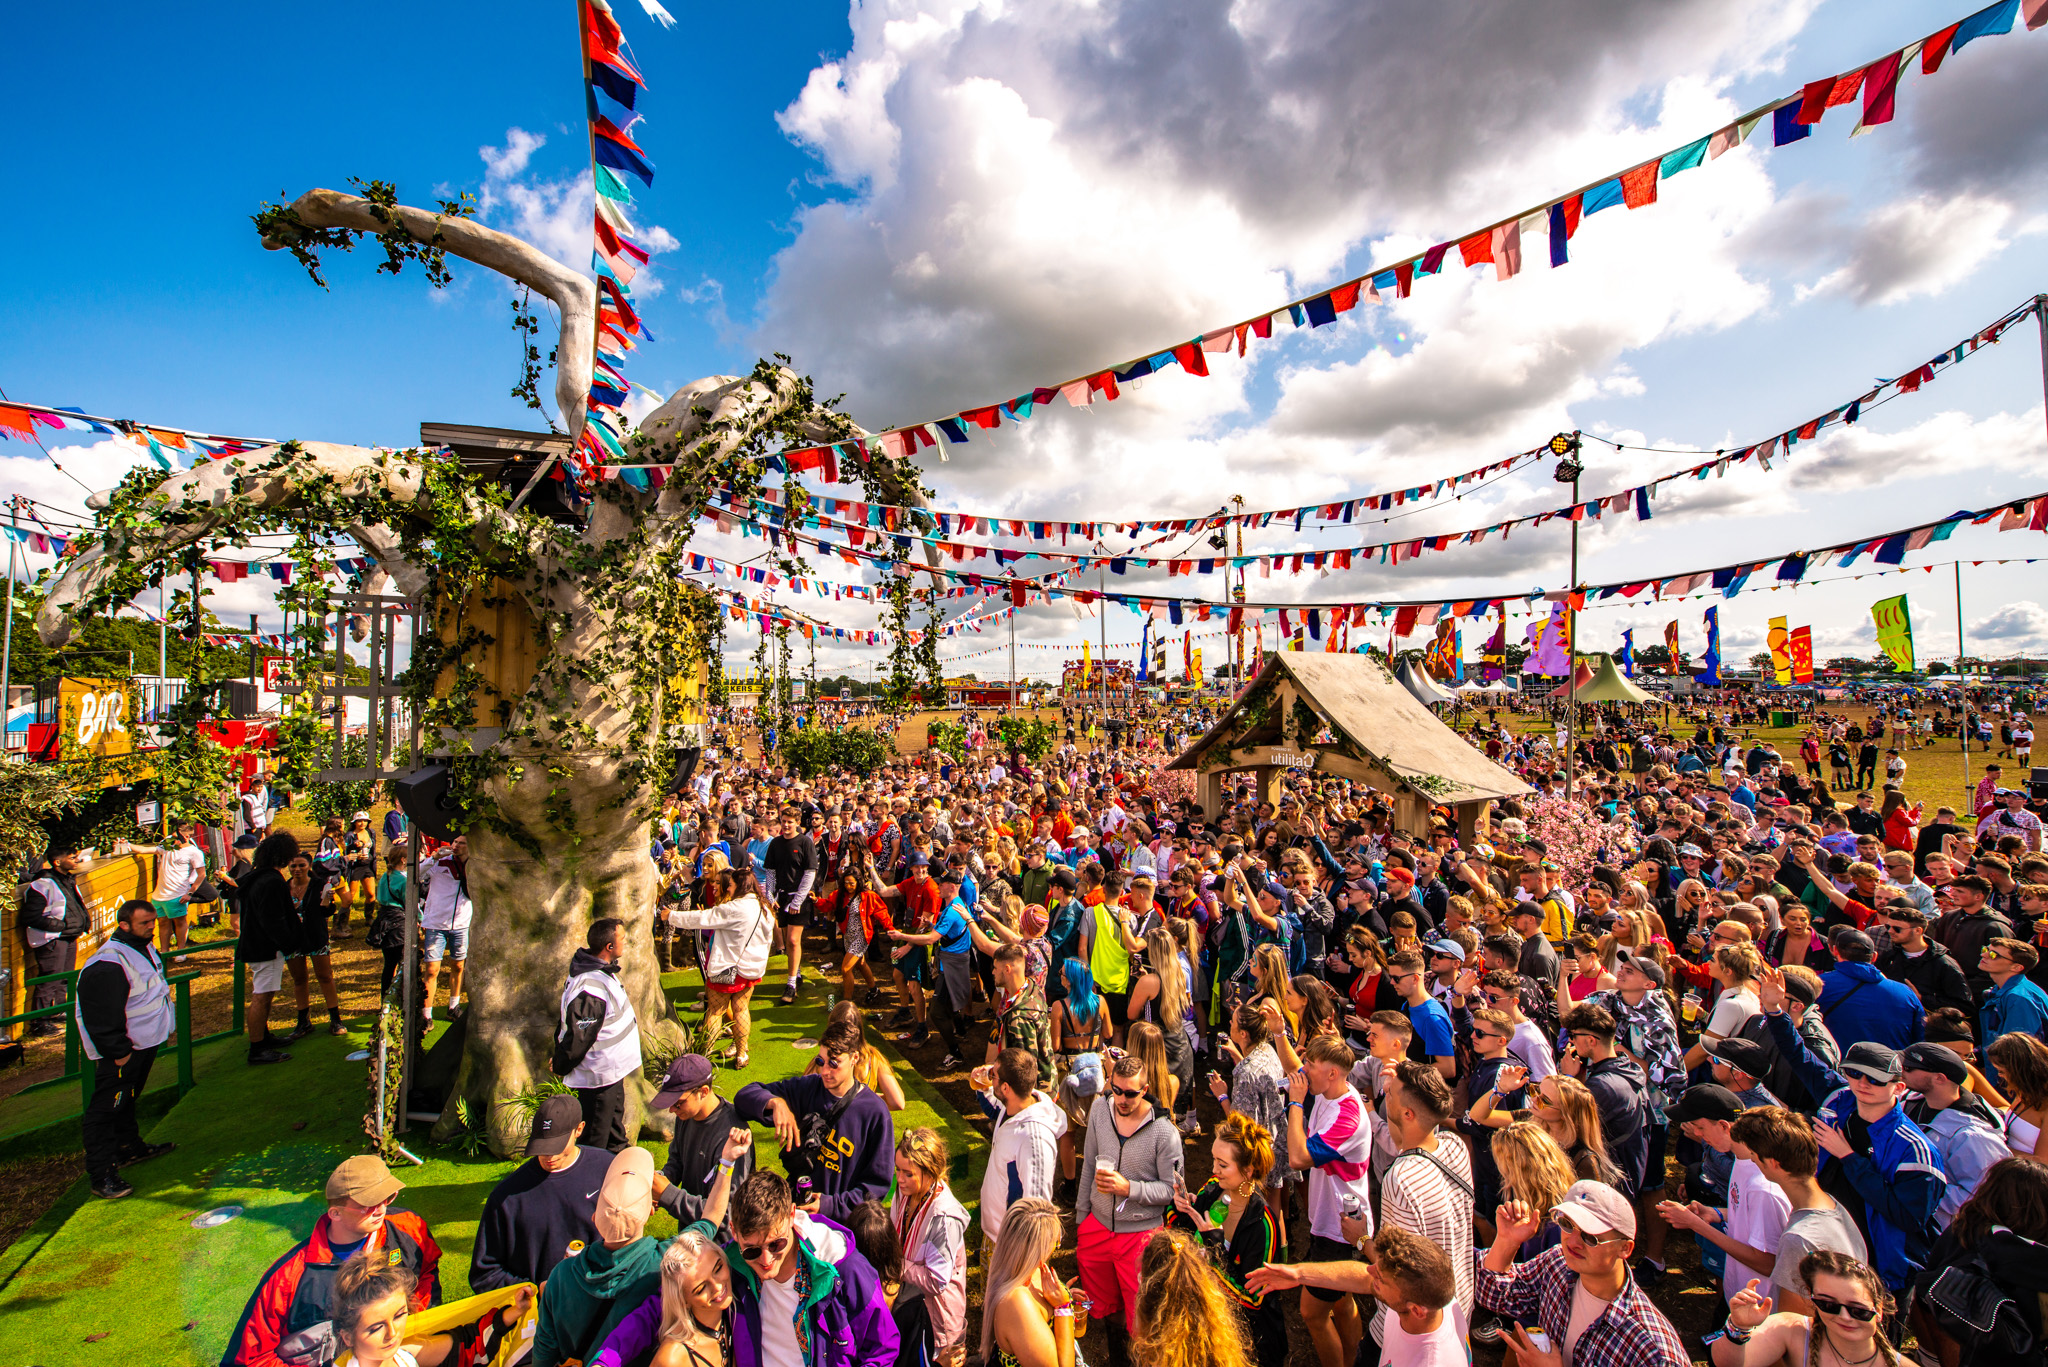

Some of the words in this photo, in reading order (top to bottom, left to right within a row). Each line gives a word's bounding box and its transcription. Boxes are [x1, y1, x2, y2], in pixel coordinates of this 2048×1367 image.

[78, 691, 124, 744] BAR
[1271, 752, 1304, 767] utilita
[78, 940, 88, 951] life
[88, 934, 99, 946] with
[99, 926, 116, 943] power
